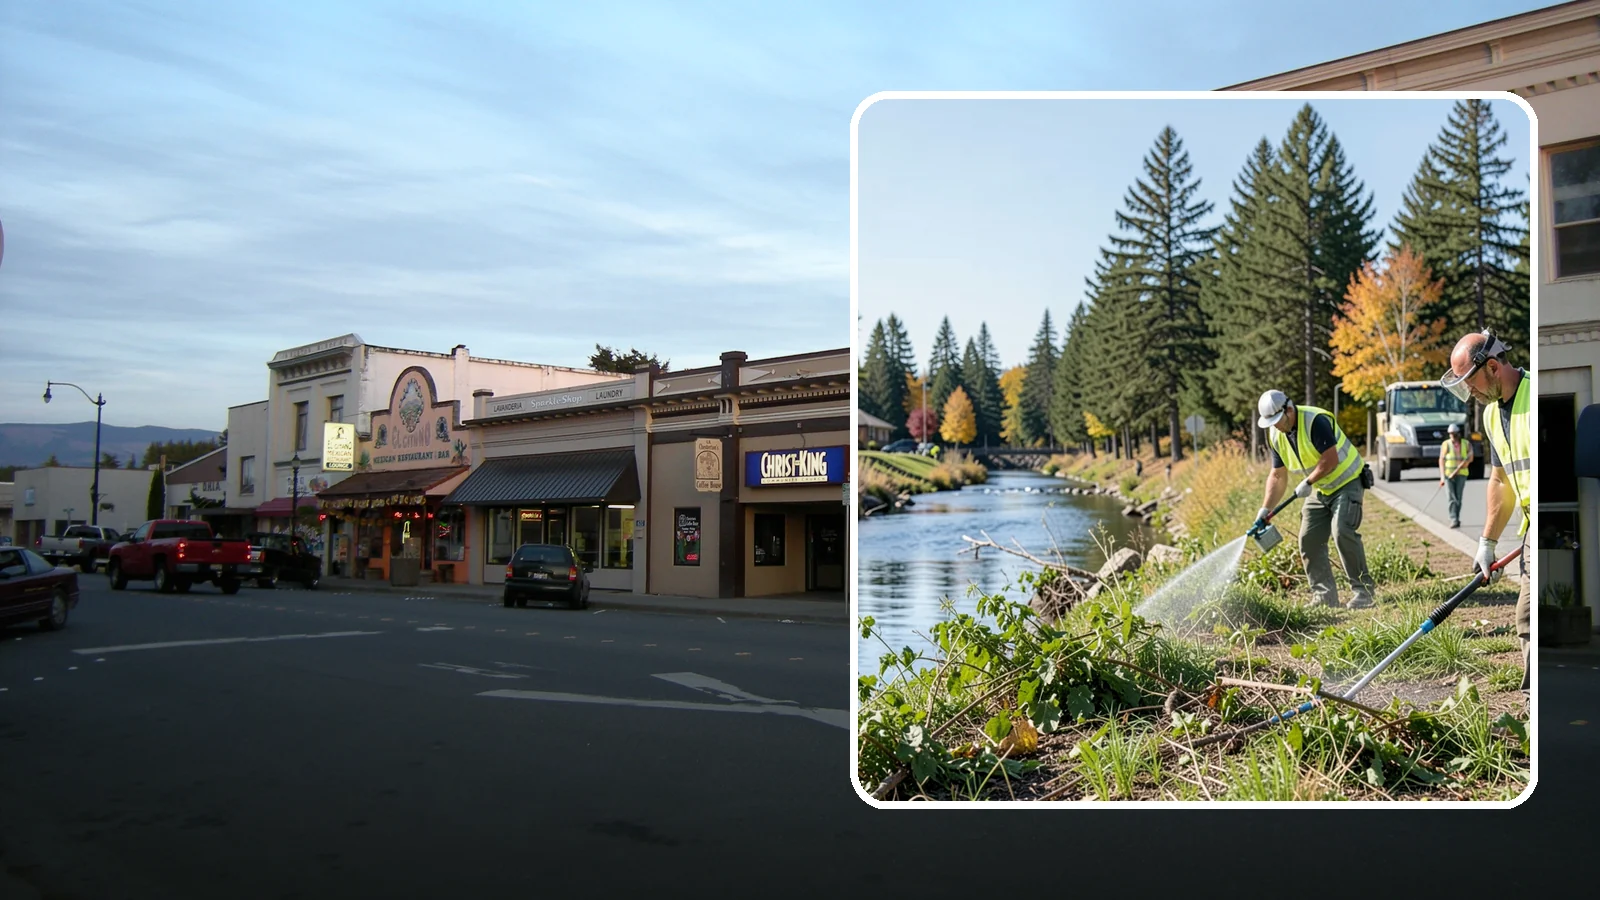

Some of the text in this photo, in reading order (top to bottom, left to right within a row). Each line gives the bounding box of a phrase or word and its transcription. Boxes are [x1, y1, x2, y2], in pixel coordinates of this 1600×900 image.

[531, 394, 582, 409] Sparkle Shop
[596, 389, 624, 400] LAUNDRY
[494, 402, 523, 412] LAVANDERIA
[374, 450, 450, 464] MEXICAN RESTAURANT BAR
[761, 452, 797, 478] CHRIST
[799, 450, 827, 476] KING
